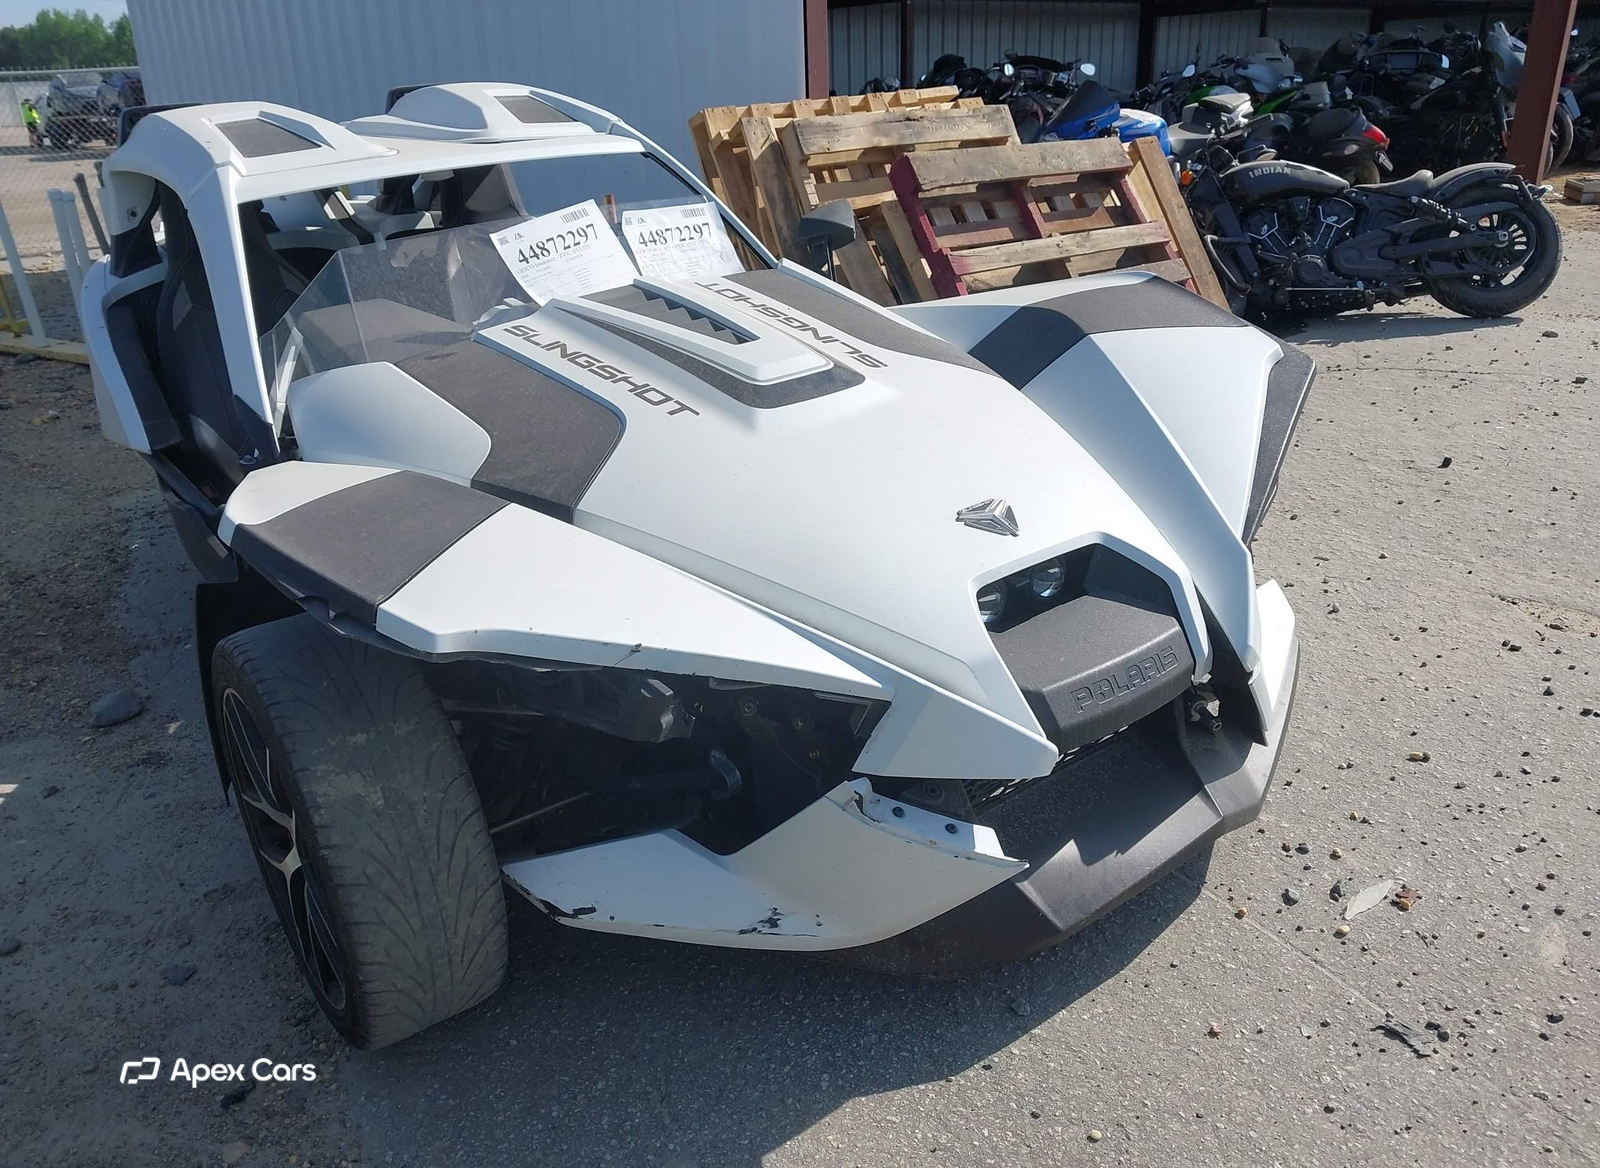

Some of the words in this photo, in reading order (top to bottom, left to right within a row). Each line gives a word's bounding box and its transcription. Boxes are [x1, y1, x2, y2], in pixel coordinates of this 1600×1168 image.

[1248, 166, 1291, 179] INDIAN
[518, 223, 598, 265] 44872297
[638, 222, 711, 247] 44872297
[694, 281, 889, 368] SLINGSHOT
[502, 324, 700, 416] SLINGSHOT
[1070, 645, 1179, 714] POLARIS
